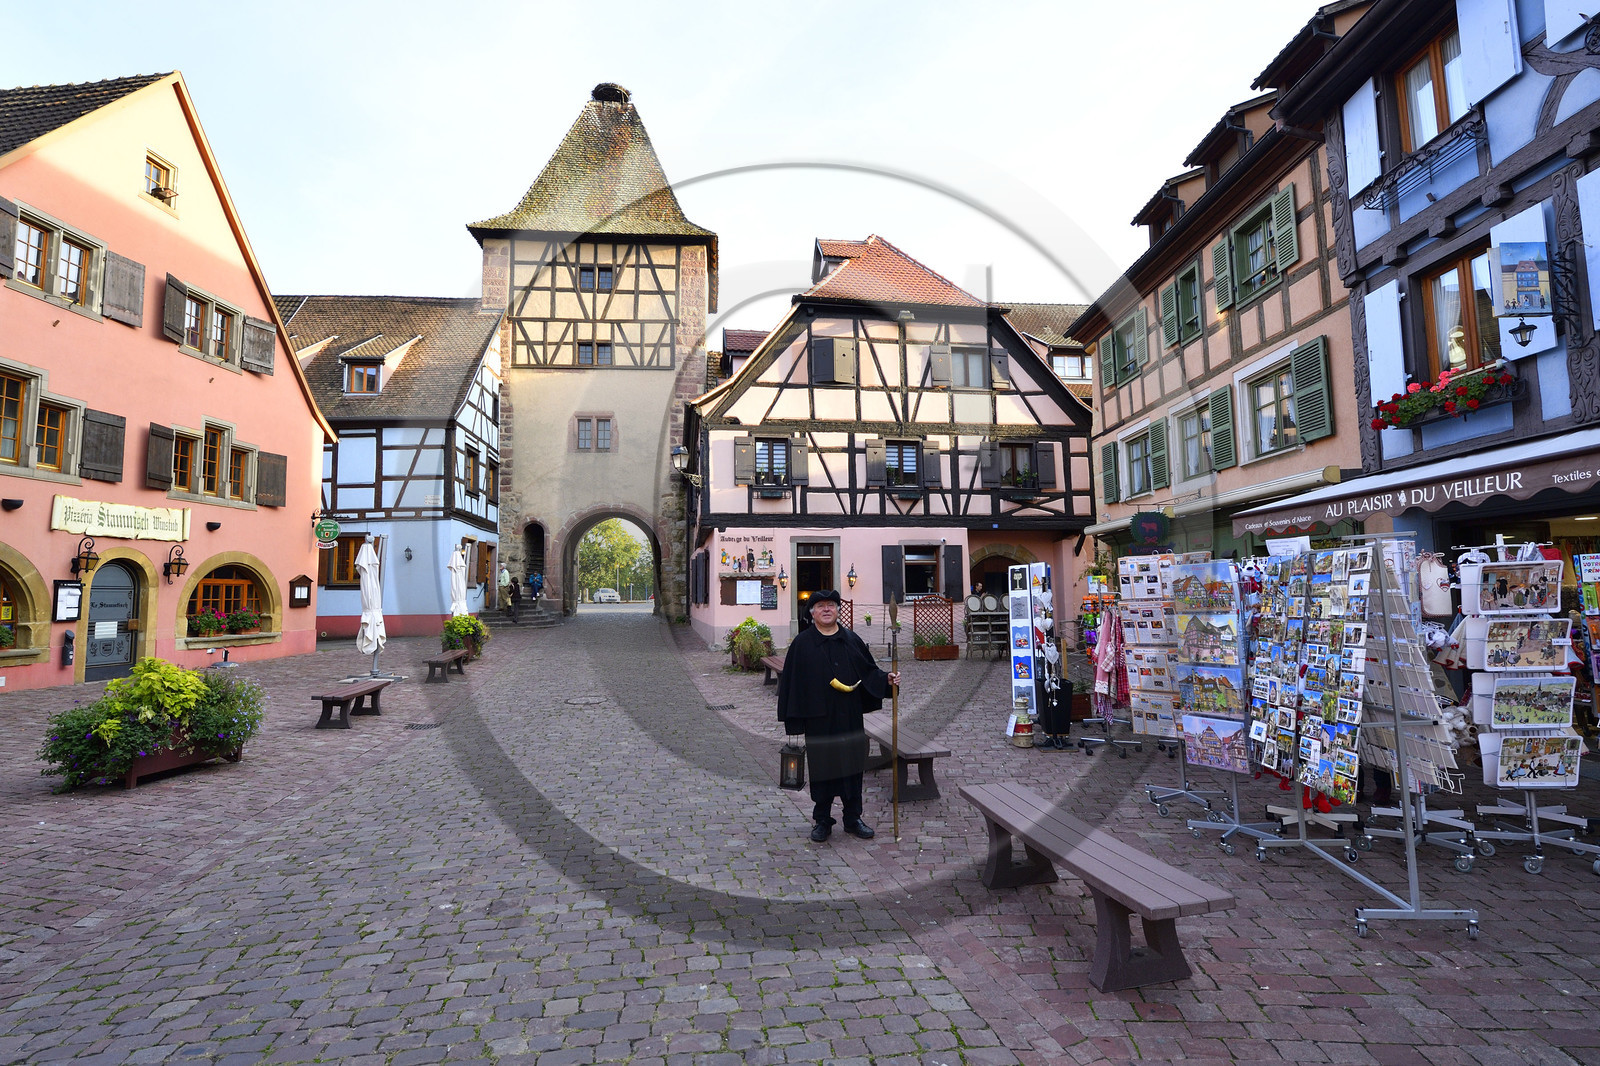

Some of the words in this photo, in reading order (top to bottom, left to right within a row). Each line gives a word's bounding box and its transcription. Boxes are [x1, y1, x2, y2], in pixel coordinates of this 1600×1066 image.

[1552, 470, 1592, 484] Textiles
[1325, 501, 1344, 519] AU
[1347, 493, 1393, 515] PLAISIR
[1411, 484, 1436, 506] DU
[1442, 471, 1523, 500] VEILLEUR
[1245, 522, 1263, 530] Cadeaux
[1269, 518, 1291, 527] Souvenirs
[1291, 515, 1312, 524] d'Alsace
